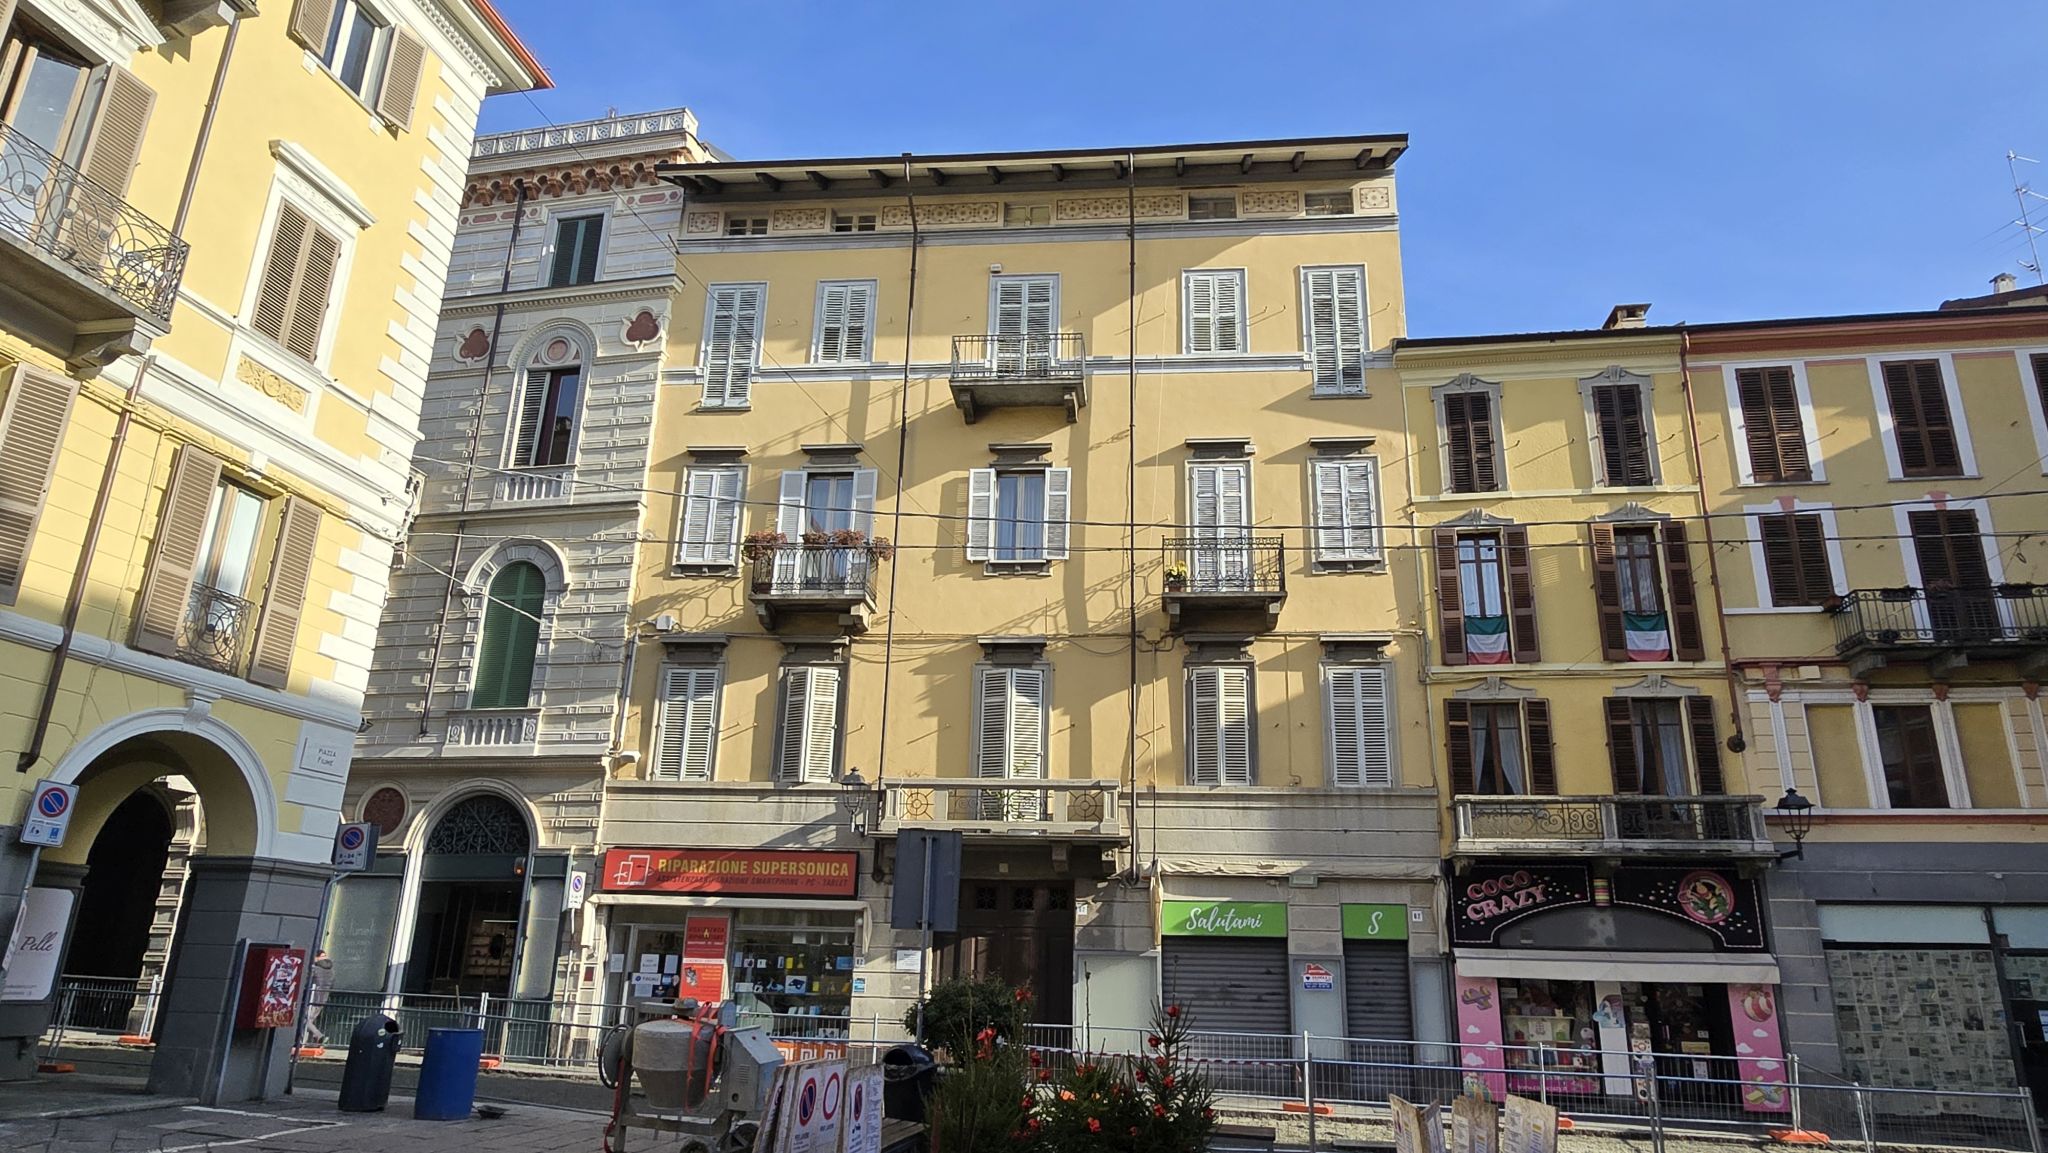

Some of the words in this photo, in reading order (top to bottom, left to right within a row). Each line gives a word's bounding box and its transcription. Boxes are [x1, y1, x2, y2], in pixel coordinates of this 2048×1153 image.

[318, 748, 336, 757] PIAZZA
[658, 859, 748, 874] RIPARAZIONE
[753, 861, 849, 877] SUPERSONICA
[1466, 870, 1532, 900] COCO
[1466, 884, 1547, 920] CRAZY
[1186, 906, 1263, 932] Salutami
[1368, 911, 1383, 935] S
[20, 931, 58, 951] Pelle
